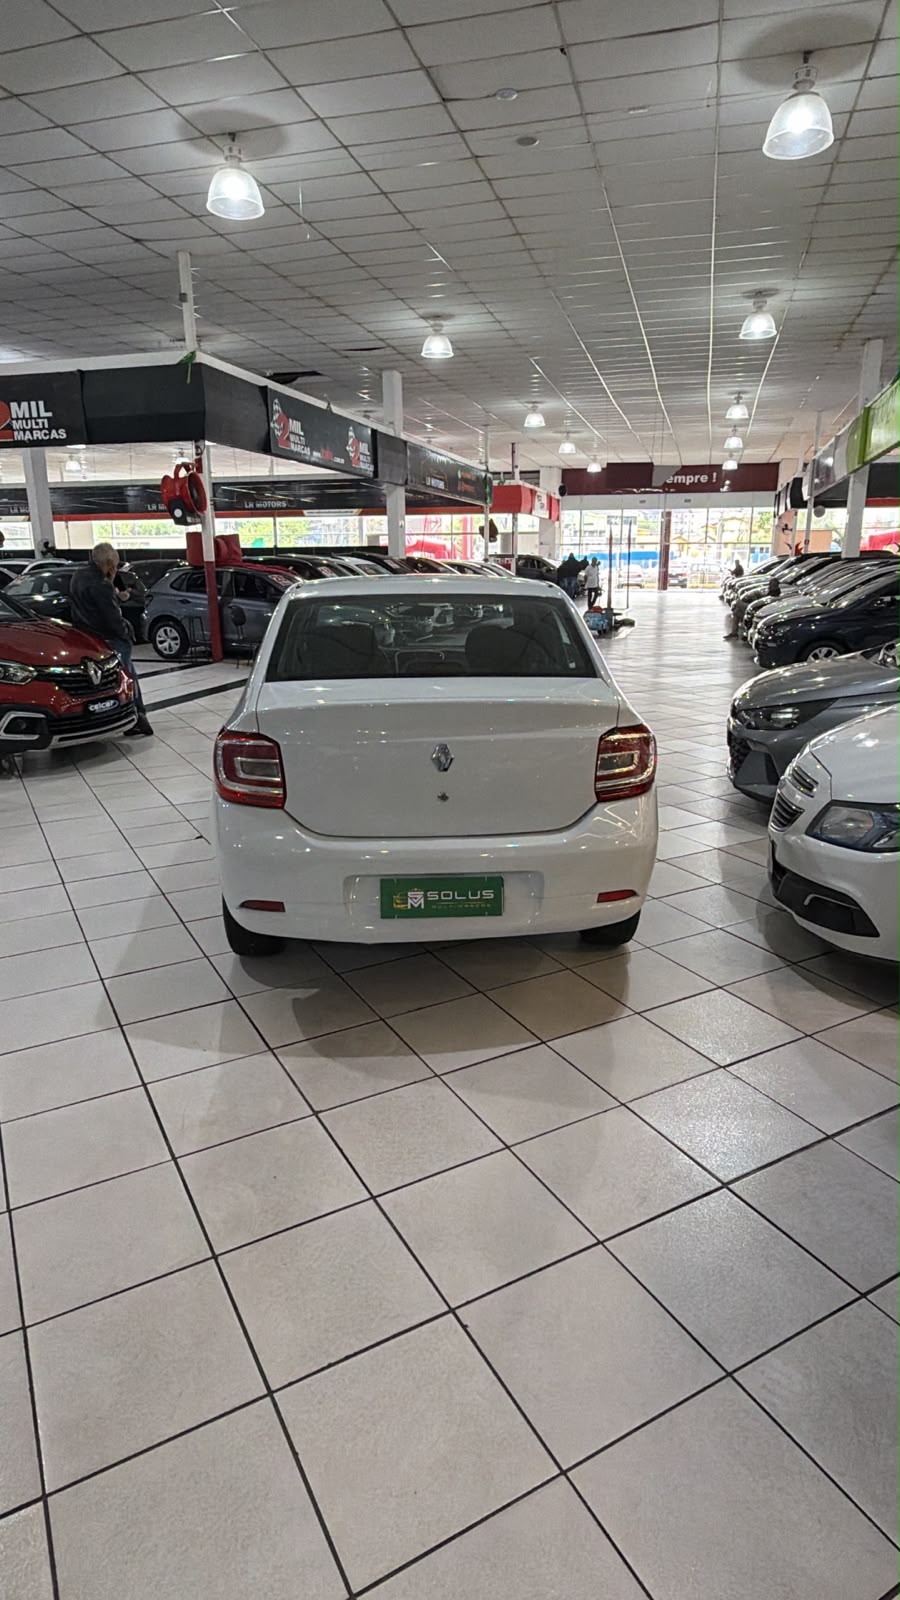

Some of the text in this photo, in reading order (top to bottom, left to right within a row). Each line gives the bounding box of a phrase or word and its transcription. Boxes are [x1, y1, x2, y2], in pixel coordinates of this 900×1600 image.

[10, 400, 53, 419] MIL
[12, 418, 49, 430] MULTI
[276, 411, 305, 449] 2 MIL
[13, 429, 67, 441] MARCAS
[289, 434, 305, 445] MULTI
[290, 442, 311, 456] MARCAS
[351, 438, 361, 468] 2
[359, 441, 370, 455] MIL
[666, 474, 708, 485] empre
[255, 500, 287, 509] MOTORS
[427, 889, 494, 900] SOLUS
